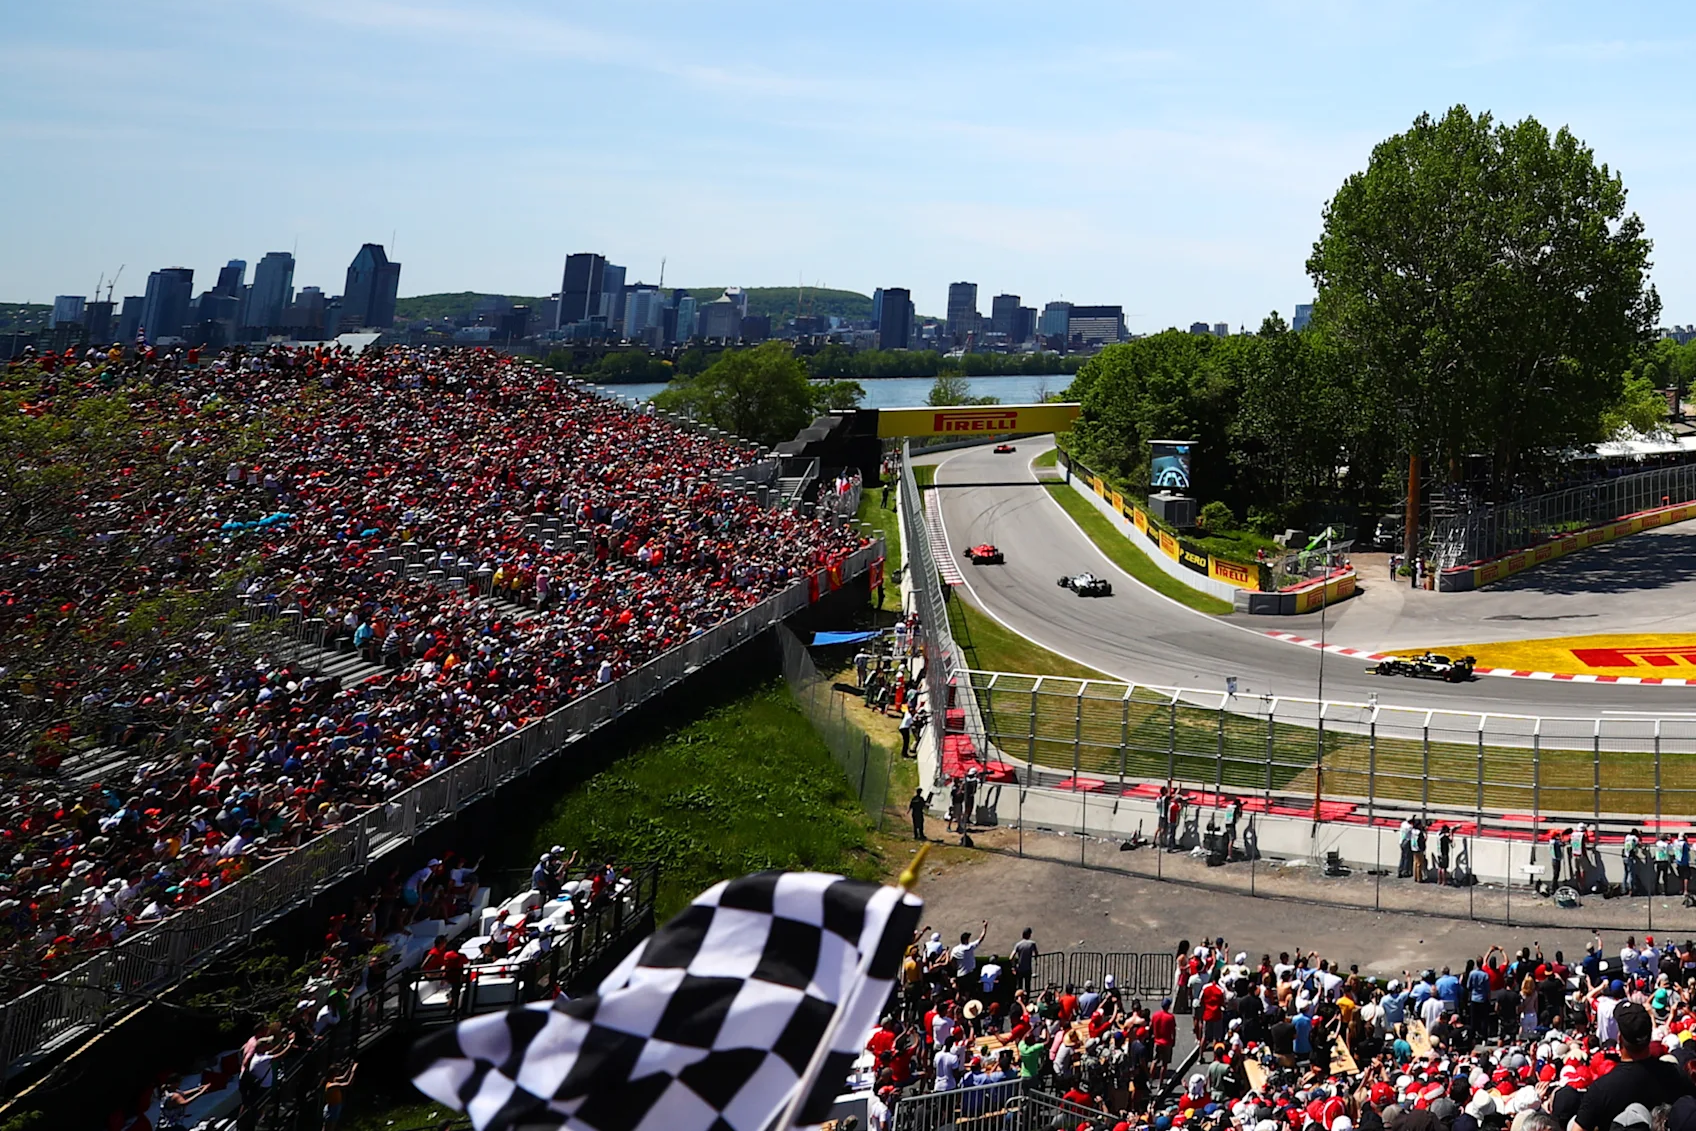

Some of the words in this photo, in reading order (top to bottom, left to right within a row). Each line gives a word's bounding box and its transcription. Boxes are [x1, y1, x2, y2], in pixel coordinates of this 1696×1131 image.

[933, 411, 1018, 432] PIRELLI
[1184, 551, 1206, 568] ZERO
[1215, 559, 1248, 583] PIRELLI
